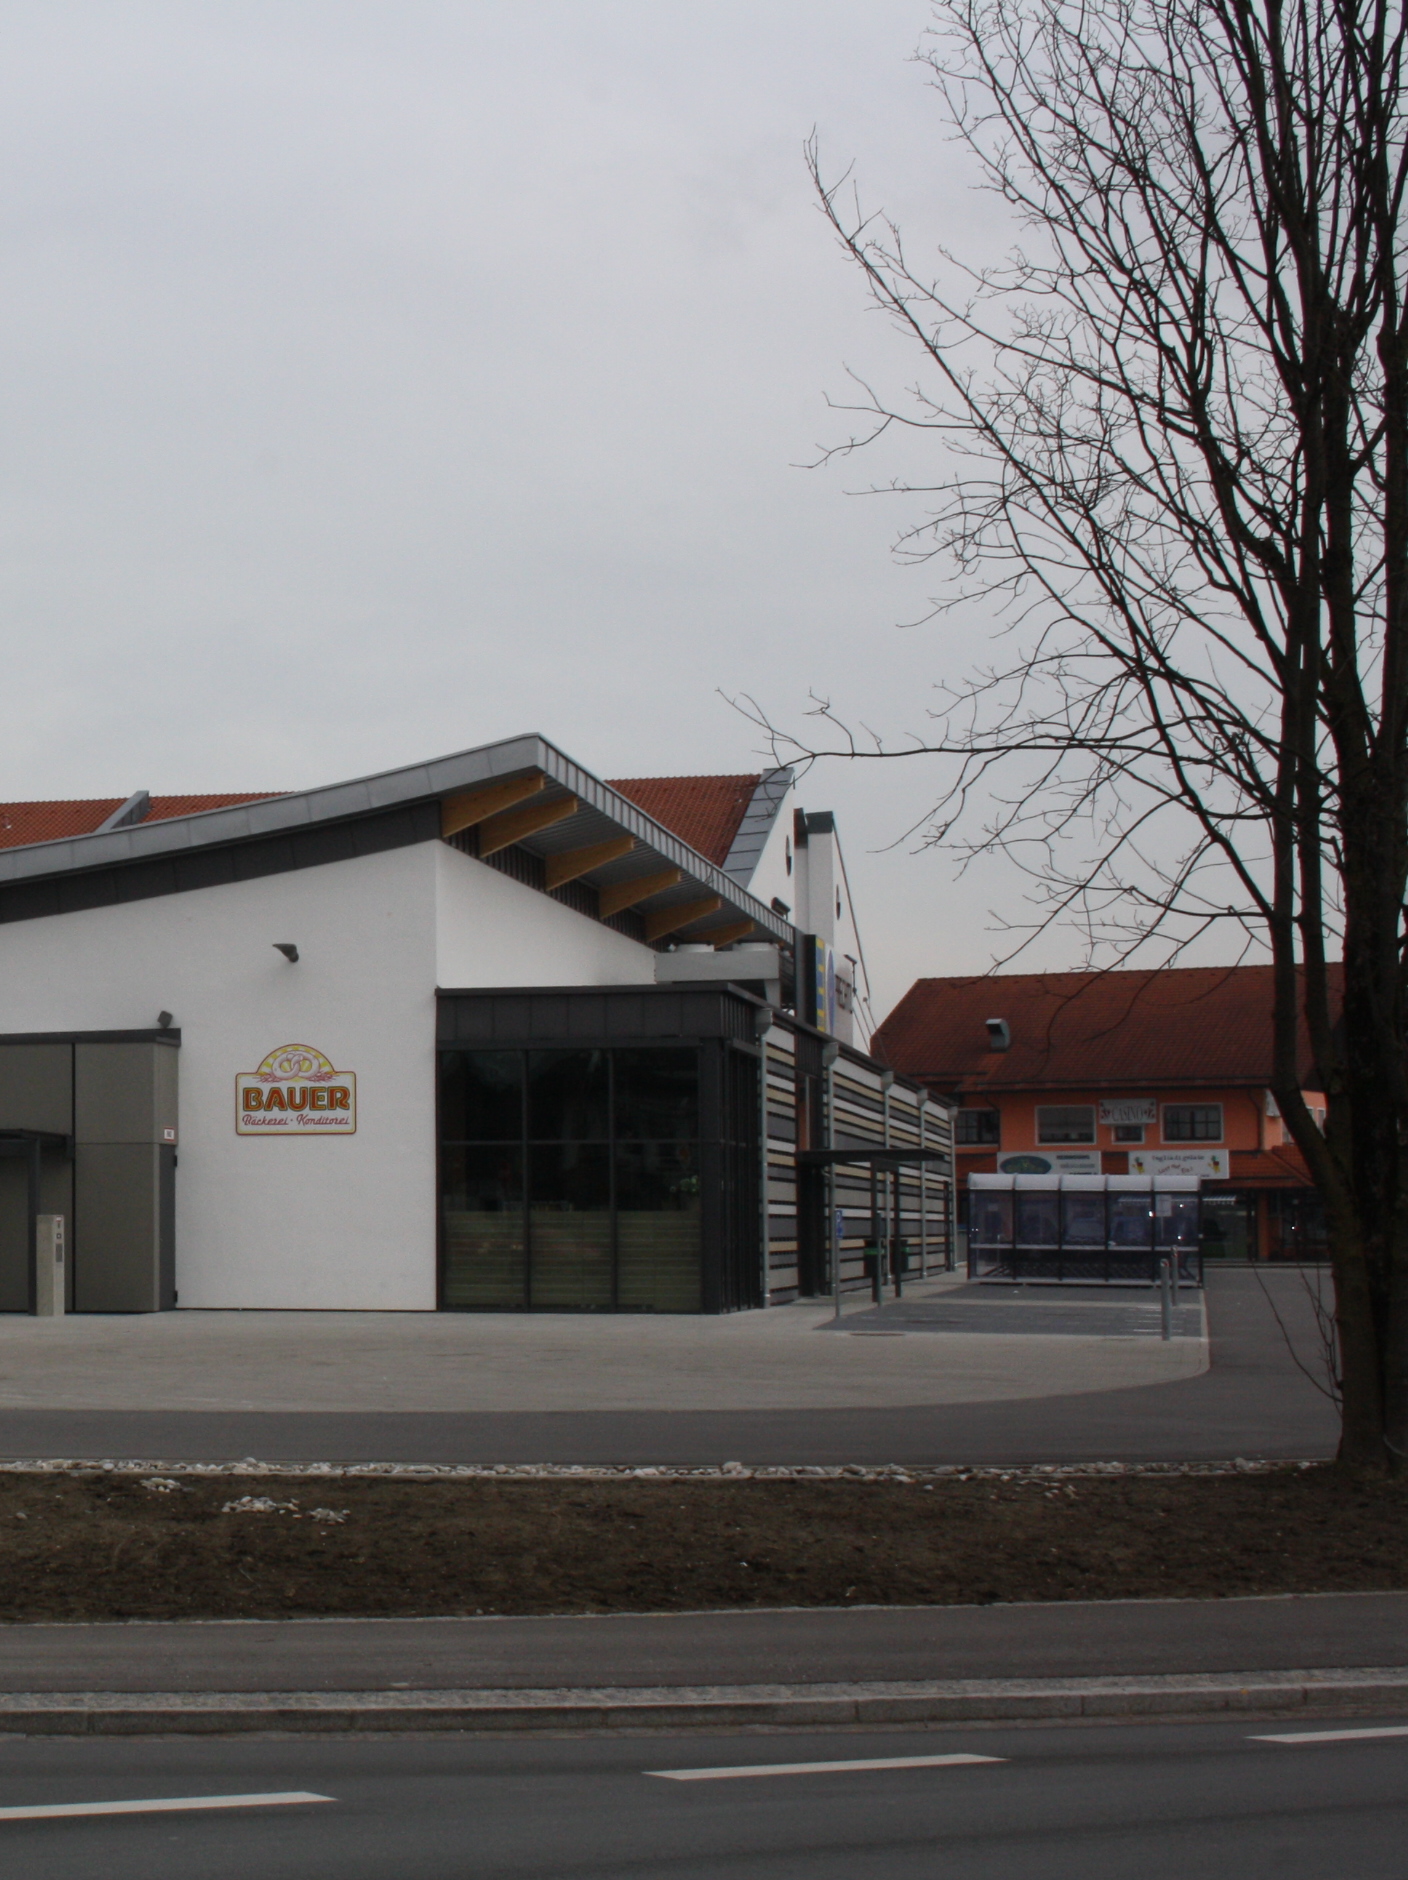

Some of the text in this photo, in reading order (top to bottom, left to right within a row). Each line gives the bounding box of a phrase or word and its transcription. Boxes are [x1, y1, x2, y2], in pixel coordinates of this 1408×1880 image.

[242, 1086, 350, 1112] BAUER
[242, 1113, 350, 1126] Bäckerei Konditorei
